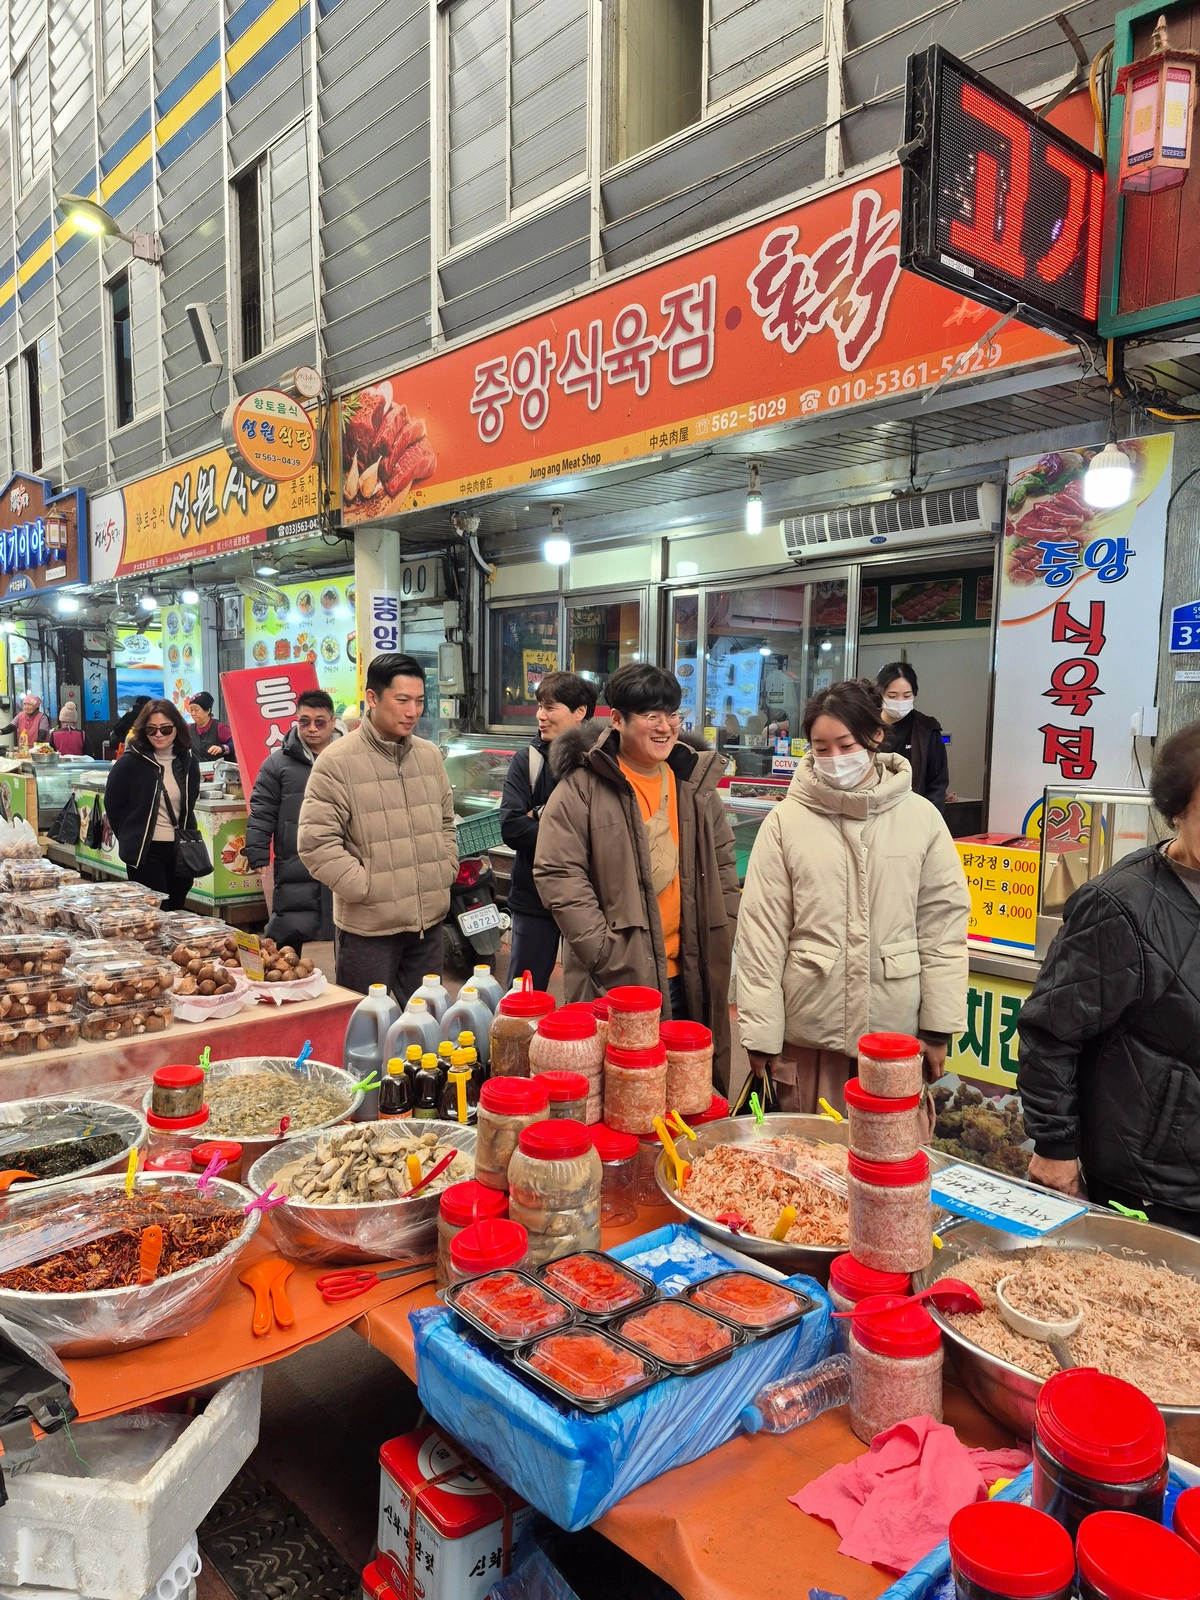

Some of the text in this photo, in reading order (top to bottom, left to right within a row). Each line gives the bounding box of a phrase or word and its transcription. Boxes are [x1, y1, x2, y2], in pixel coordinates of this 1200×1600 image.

[951, 84, 1104, 321] 고기
[470, 274, 717, 443] 중앙식육점
[711, 343, 1003, 432] 562-5029 010-5361-5029
[254, 397, 298, 417] 향토음식
[650, 427, 689, 449] 中央肉屋
[262, 454, 301, 467] 563-0439
[529, 452, 601, 479] Jung ang Meat Shop
[459, 477, 493, 495] 中央肉食店
[135, 504, 165, 533] 향토음식
[1035, 537, 1137, 587] 중앙
[373, 596, 399, 651] 중앙
[89, 659, 104, 720] 어서오세요
[1039, 600, 1107, 780] 식육점
[774, 760, 792, 768] CCTV
[963, 853, 1036, 873] 닭강정 9,000
[1001, 882, 1034, 897] 8,000
[473, 915, 496, 929] 8721
[999, 904, 1032, 919] 4,000
